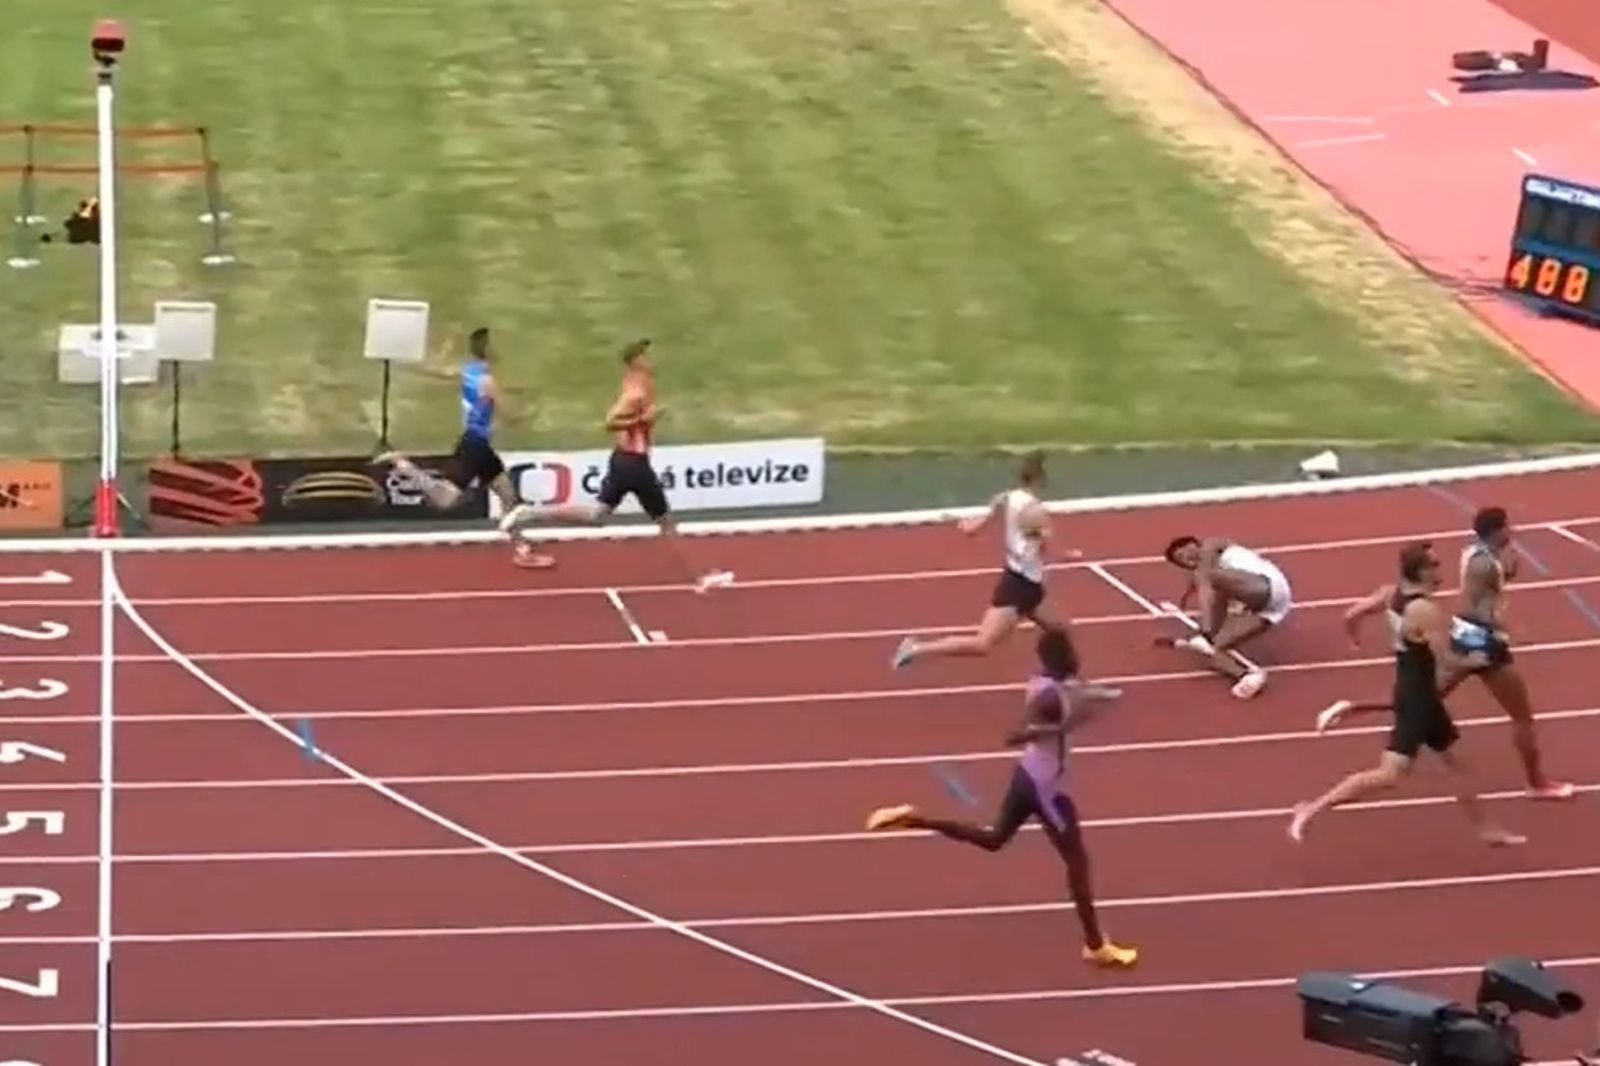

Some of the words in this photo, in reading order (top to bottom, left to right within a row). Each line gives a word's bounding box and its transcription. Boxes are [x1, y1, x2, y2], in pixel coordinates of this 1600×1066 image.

[685, 459, 809, 488] televize
[0, 621, 69, 639] 2
[0, 811, 65, 834] 5
[0, 968, 59, 997] 7
